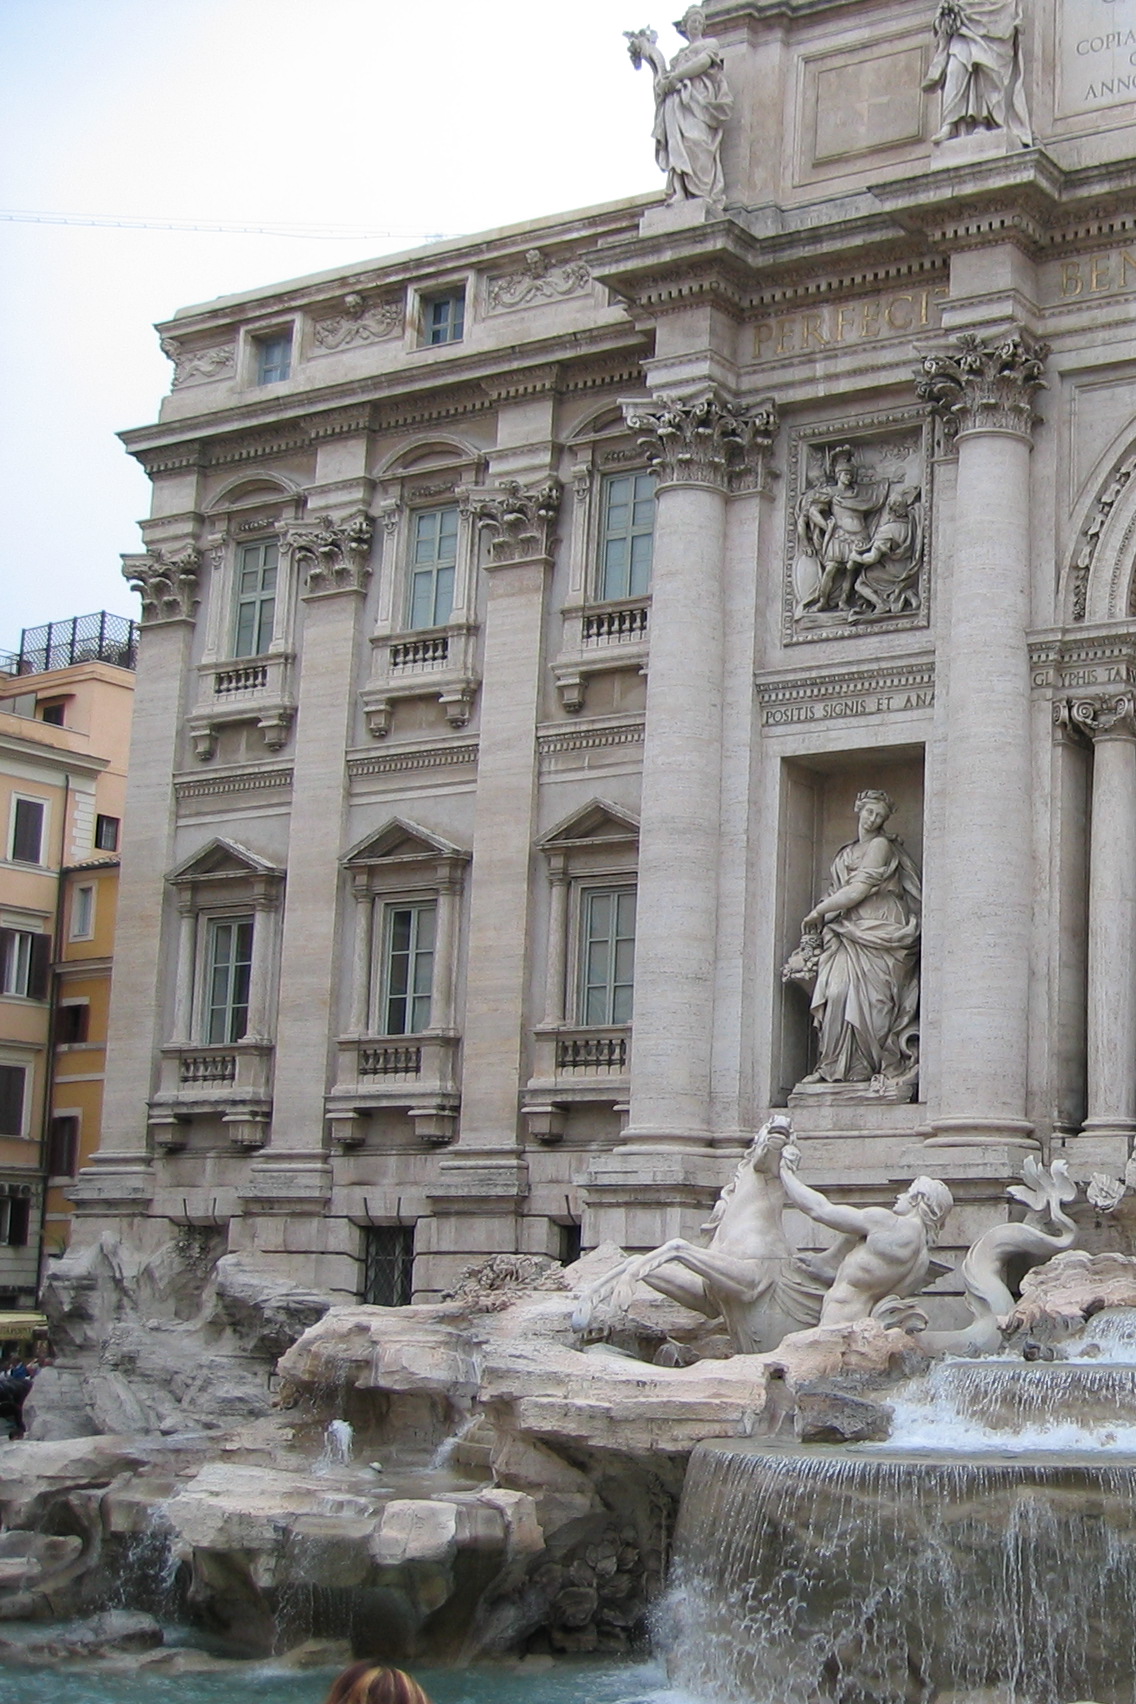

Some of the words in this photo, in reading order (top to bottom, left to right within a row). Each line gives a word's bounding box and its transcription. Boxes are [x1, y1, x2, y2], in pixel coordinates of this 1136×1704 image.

[1076, 30, 1136, 56] COPIA
[765, 705, 815, 724] POSITIS
[822, 700, 866, 718] SIGNIS
[876, 696, 894, 712] ET
